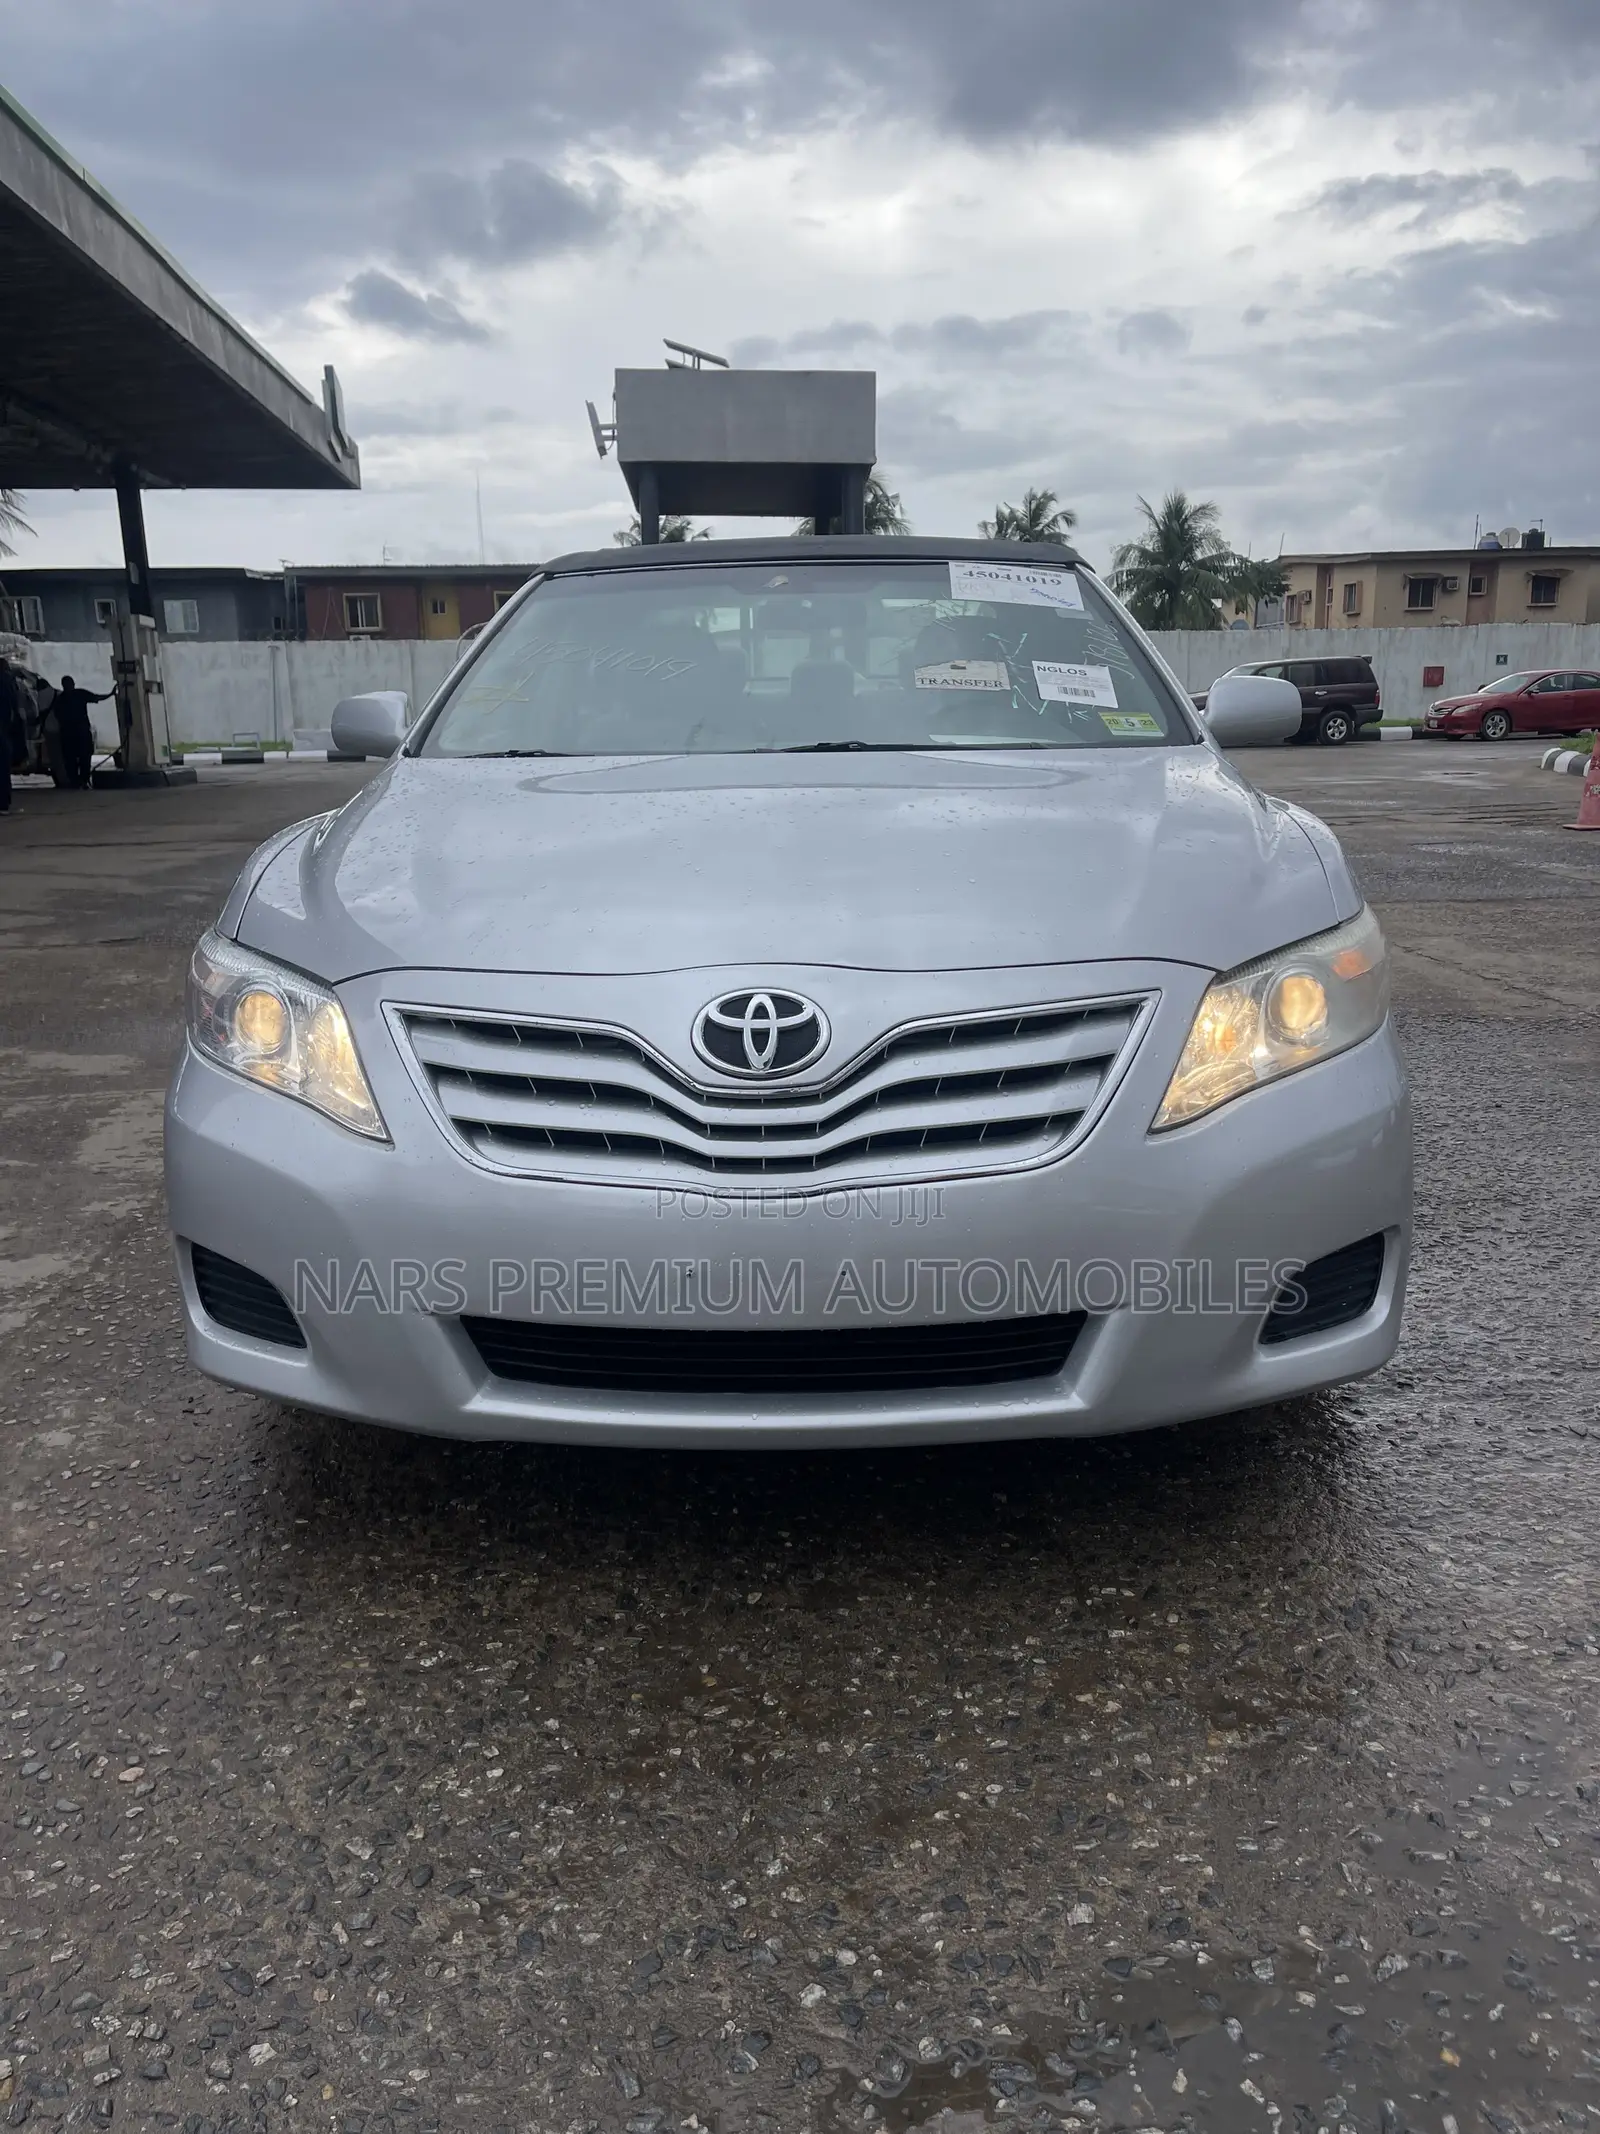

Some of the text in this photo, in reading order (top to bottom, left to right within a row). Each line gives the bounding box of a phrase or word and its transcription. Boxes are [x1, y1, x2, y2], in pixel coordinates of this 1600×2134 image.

[963, 570, 1062, 586] 45041019
[1036, 665, 1088, 676] NGLOS
[917, 677, 1004, 688] TRANSFER
[1124, 717, 1135, 727] 5
